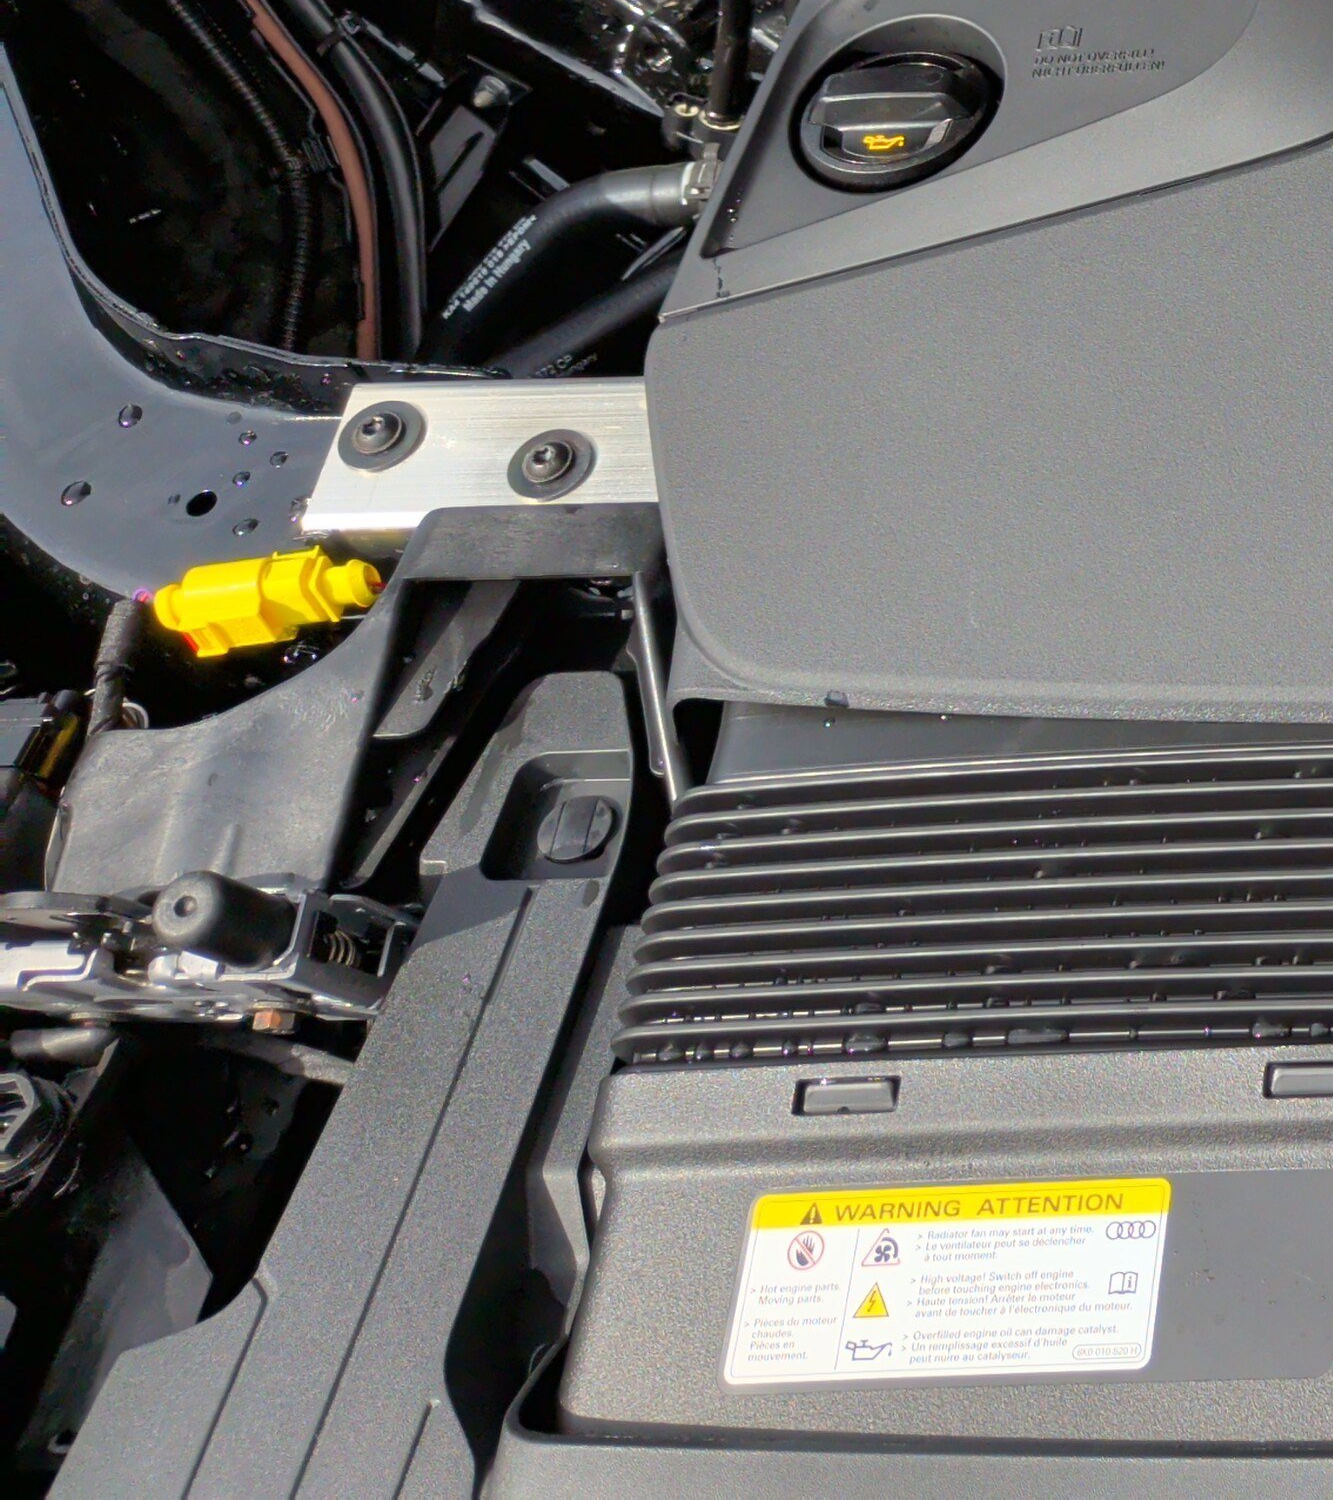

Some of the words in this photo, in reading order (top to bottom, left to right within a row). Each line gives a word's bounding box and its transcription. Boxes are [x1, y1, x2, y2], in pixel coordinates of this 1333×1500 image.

[834, 1199, 962, 1223] WARNING
[977, 1193, 1125, 1217] ATTENTION
[927, 1229, 969, 1240] Radiator
[970, 1229, 986, 1238] fan
[989, 1228, 1009, 1239] may
[1013, 1228, 1034, 1236] start
[1037, 1228, 1047, 1236] at
[1049, 1227, 1067, 1237] any
[1070, 1224, 1094, 1235] time.
[925, 1242, 937, 1251] Le
[940, 1240, 991, 1250] ventilateur
[994, 1239, 1016, 1250] peut
[1032, 1237, 1086, 1247] déclencher
[932, 1252, 952, 1262] tout
[955, 1251, 998, 1261] moment.
[920, 1274, 943, 1285] High
[946, 1273, 986, 1285] voltage!
[989, 1271, 1021, 1282] Switch
[1025, 1270, 1038, 1280] off
[1040, 1269, 1074, 1280] engine
[760, 1285, 777, 1294] Hot
[780, 1284, 813, 1295] engine
[919, 1286, 951, 1295] before
[952, 1284, 996, 1295] touching
[999, 1283, 1032, 1294] engine
[1035, 1280, 1090, 1291] electronics.
[758, 1296, 797, 1306] Moving
[917, 1297, 946, 1307] Haute
[948, 1296, 988, 1305] tension!
[991, 1294, 1025, 1304] Arrêter
[1039, 1293, 1075, 1302] moteur
[915, 1308, 942, 1318] avant
[945, 1307, 957, 1317] de
[959, 1306, 997, 1317] toucher
[1079, 1303, 1091, 1312] du
[1094, 1302, 1133, 1312] moteur.
[787, 1317, 800, 1326] du
[802, 1317, 837, 1325] moteur
[913, 1330, 961, 1341] Overfilled
[963, 1329, 997, 1340] engine
[1000, 1328, 1013, 1338] oil
[1015, 1328, 1032, 1337] can
[1034, 1326, 1075, 1337] damage
[1078, 1324, 1120, 1336] catalyst.
[750, 1340, 780, 1350] Pièces
[783, 1341, 795, 1349] en
[911, 1342, 924, 1352] Un
[926, 1340, 989, 1354] remplissage
[991, 1338, 1031, 1349] excessif
[1033, 1337, 1068, 1347] d'huile
[747, 1351, 808, 1361] mouvement.
[909, 1354, 931, 1365] peut
[934, 1354, 960, 1363] nuire
[962, 1353, 974, 1362] au
[977, 1351, 1032, 1362] catalyseur.
